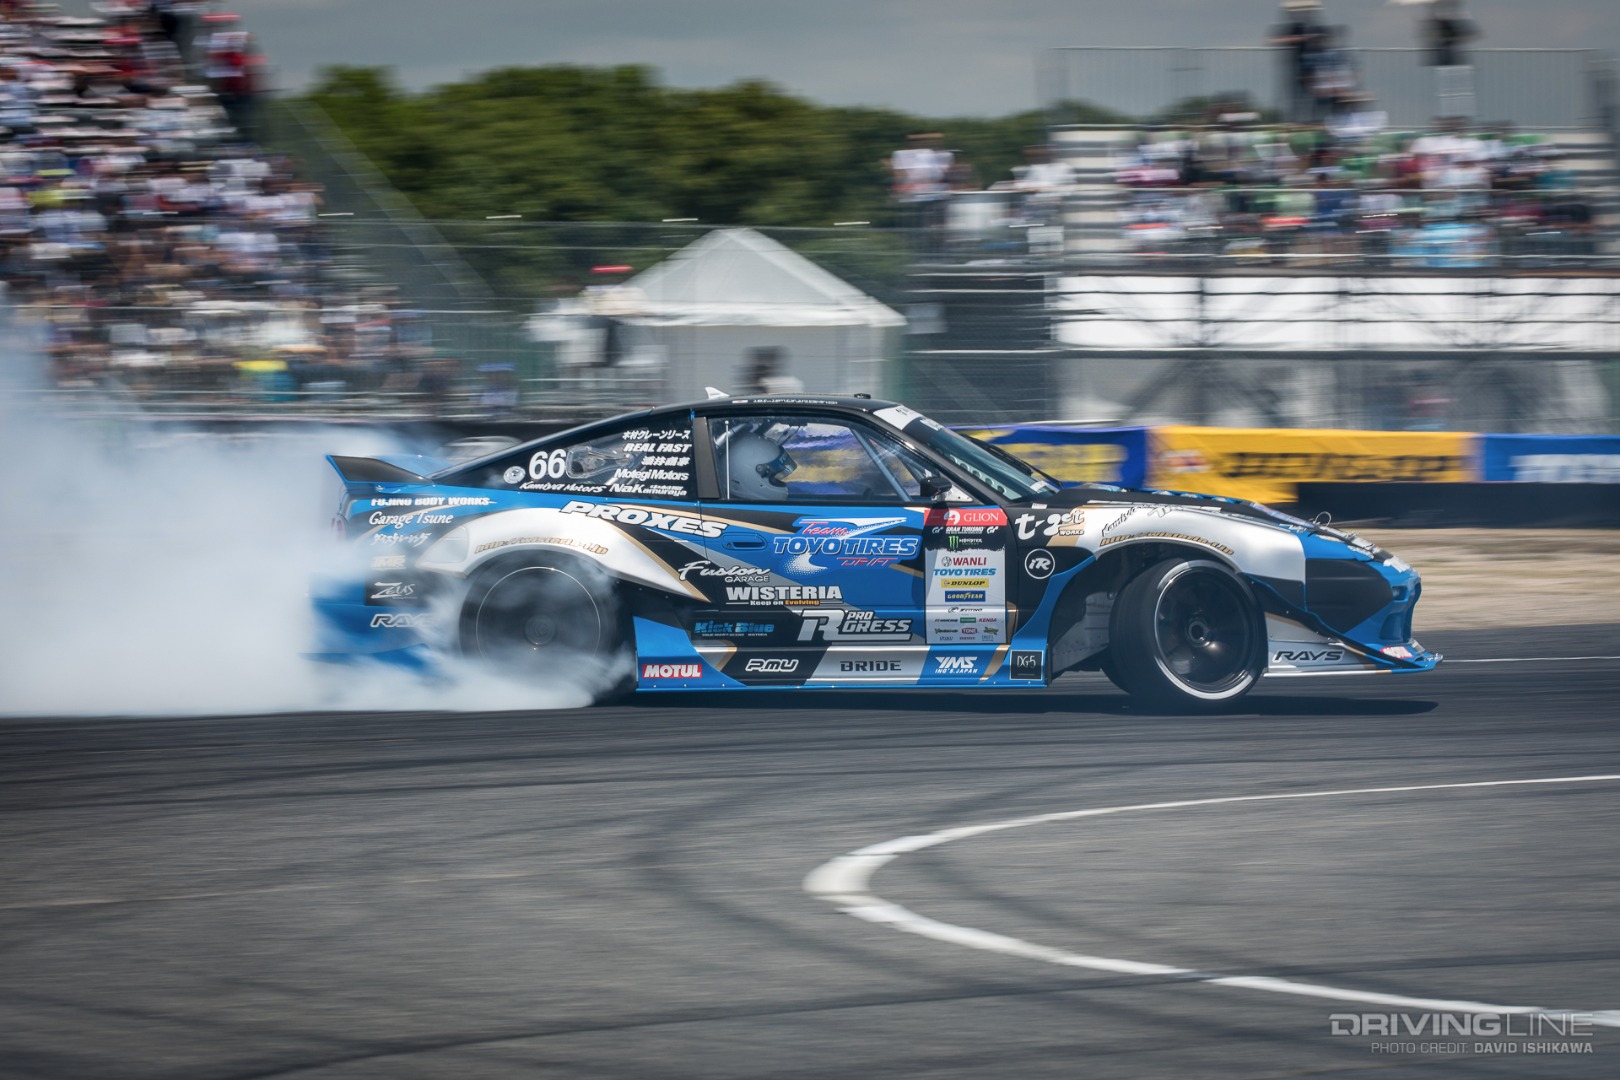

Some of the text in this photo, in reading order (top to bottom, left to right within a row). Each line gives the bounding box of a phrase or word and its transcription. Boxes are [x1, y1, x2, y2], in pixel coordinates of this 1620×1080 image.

[623, 443, 692, 453] REAL FAST
[529, 449, 567, 480] 66
[614, 468, 690, 482] Motegi Motors
[564, 484, 607, 493] Motors
[414, 497, 445, 506] BODY
[448, 497, 491, 506] WORKS
[368, 511, 454, 529] Garage Tsune
[559, 500, 728, 538] PROXES
[963, 513, 999, 522] GLION
[798, 521, 847, 536] Team
[773, 537, 918, 556] TOYO TIRES
[836, 556, 898, 567] DRIFT
[953, 557, 987, 566] WANLI
[678, 561, 771, 581] Fusion
[934, 568, 997, 576] TOYO TIRES
[724, 575, 770, 583] GARAGE
[726, 586, 843, 601] WISTERIA
[370, 613, 436, 628] RAY
[848, 611, 873, 621] PRO
[695, 620, 775, 634] Kick Blue
[843, 620, 912, 632] GRESS
[1273, 650, 1346, 663] RAYS
[644, 664, 701, 678] MOTUL
[840, 660, 901, 672] BRIDE
